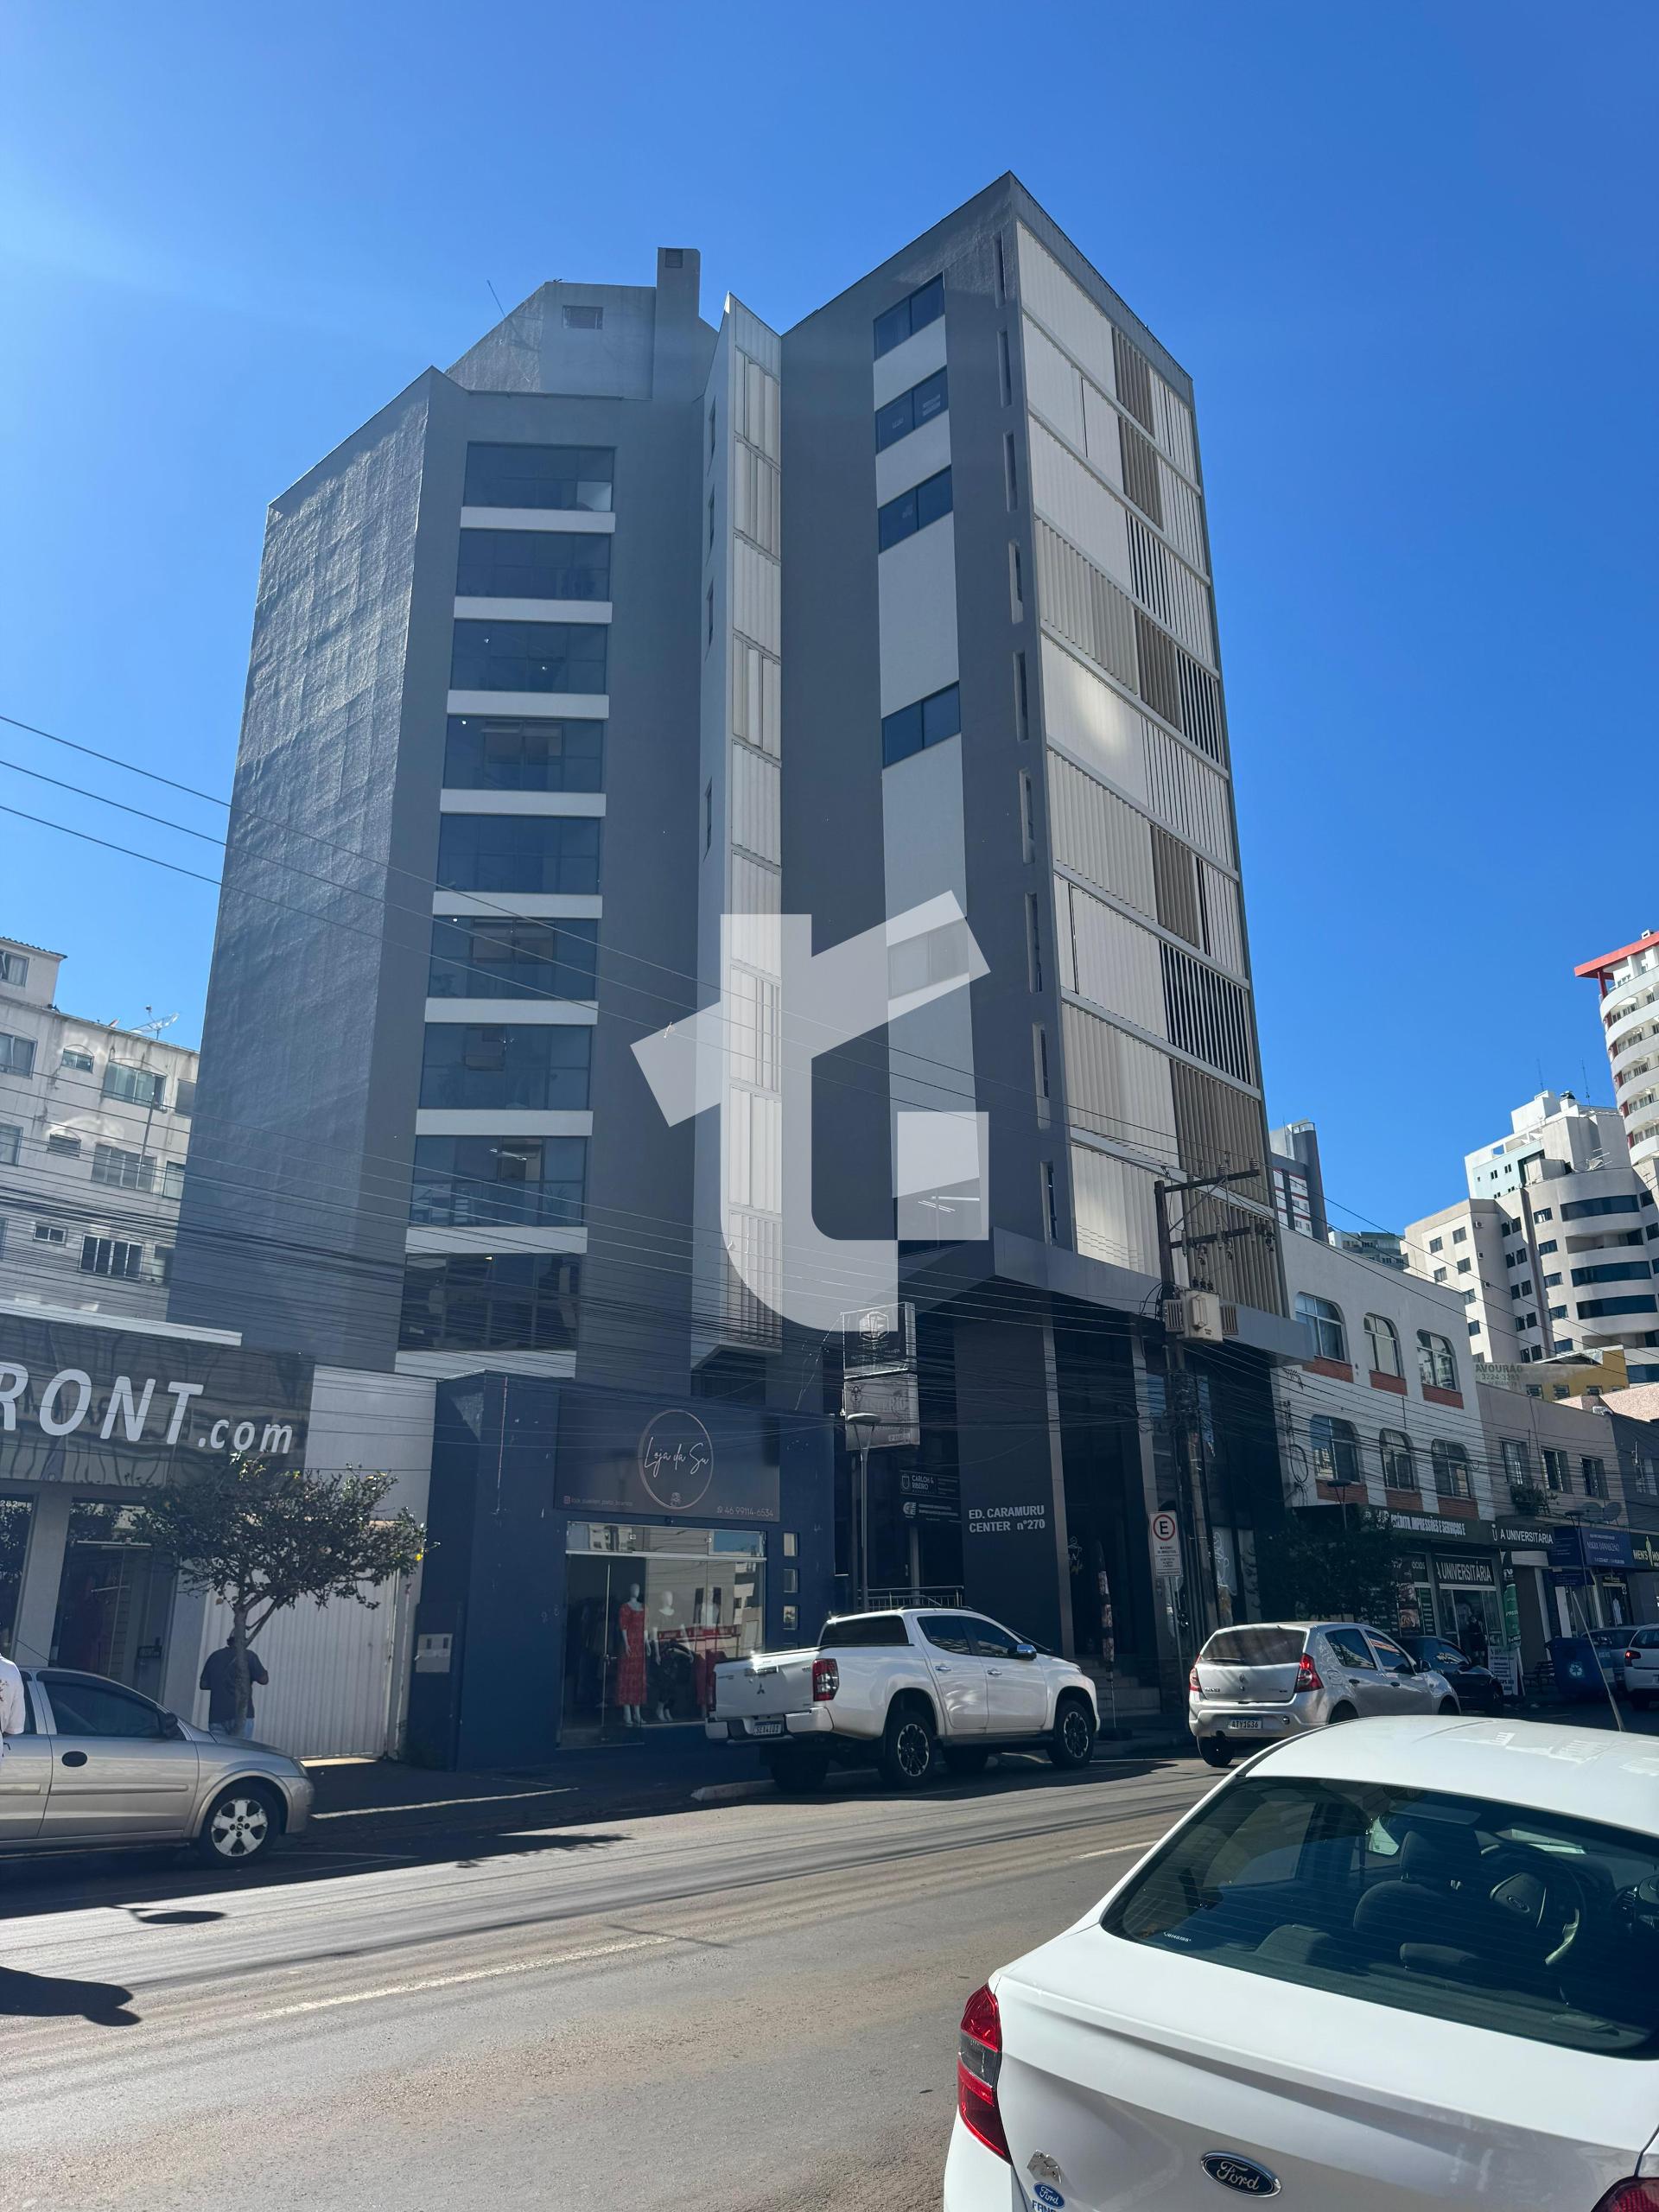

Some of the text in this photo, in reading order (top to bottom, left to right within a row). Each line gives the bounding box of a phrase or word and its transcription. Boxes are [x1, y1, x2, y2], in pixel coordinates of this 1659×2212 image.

[644, 1436, 709, 1478] Loja da Su
[968, 1509, 985, 1520] ED.
[987, 1504, 1046, 1518] CARAMURU
[969, 1521, 1011, 1533] CENTER
[1159, 1520, 1169, 1535] E
[1500, 1529, 1554, 1545] A UNIVERSITÁRIA
[1440, 1560, 1492, 1582] UNIVERSITÁRIA
[1217, 2161, 1260, 2190] Ford
[1039, 2186, 1059, 2205] Ford
